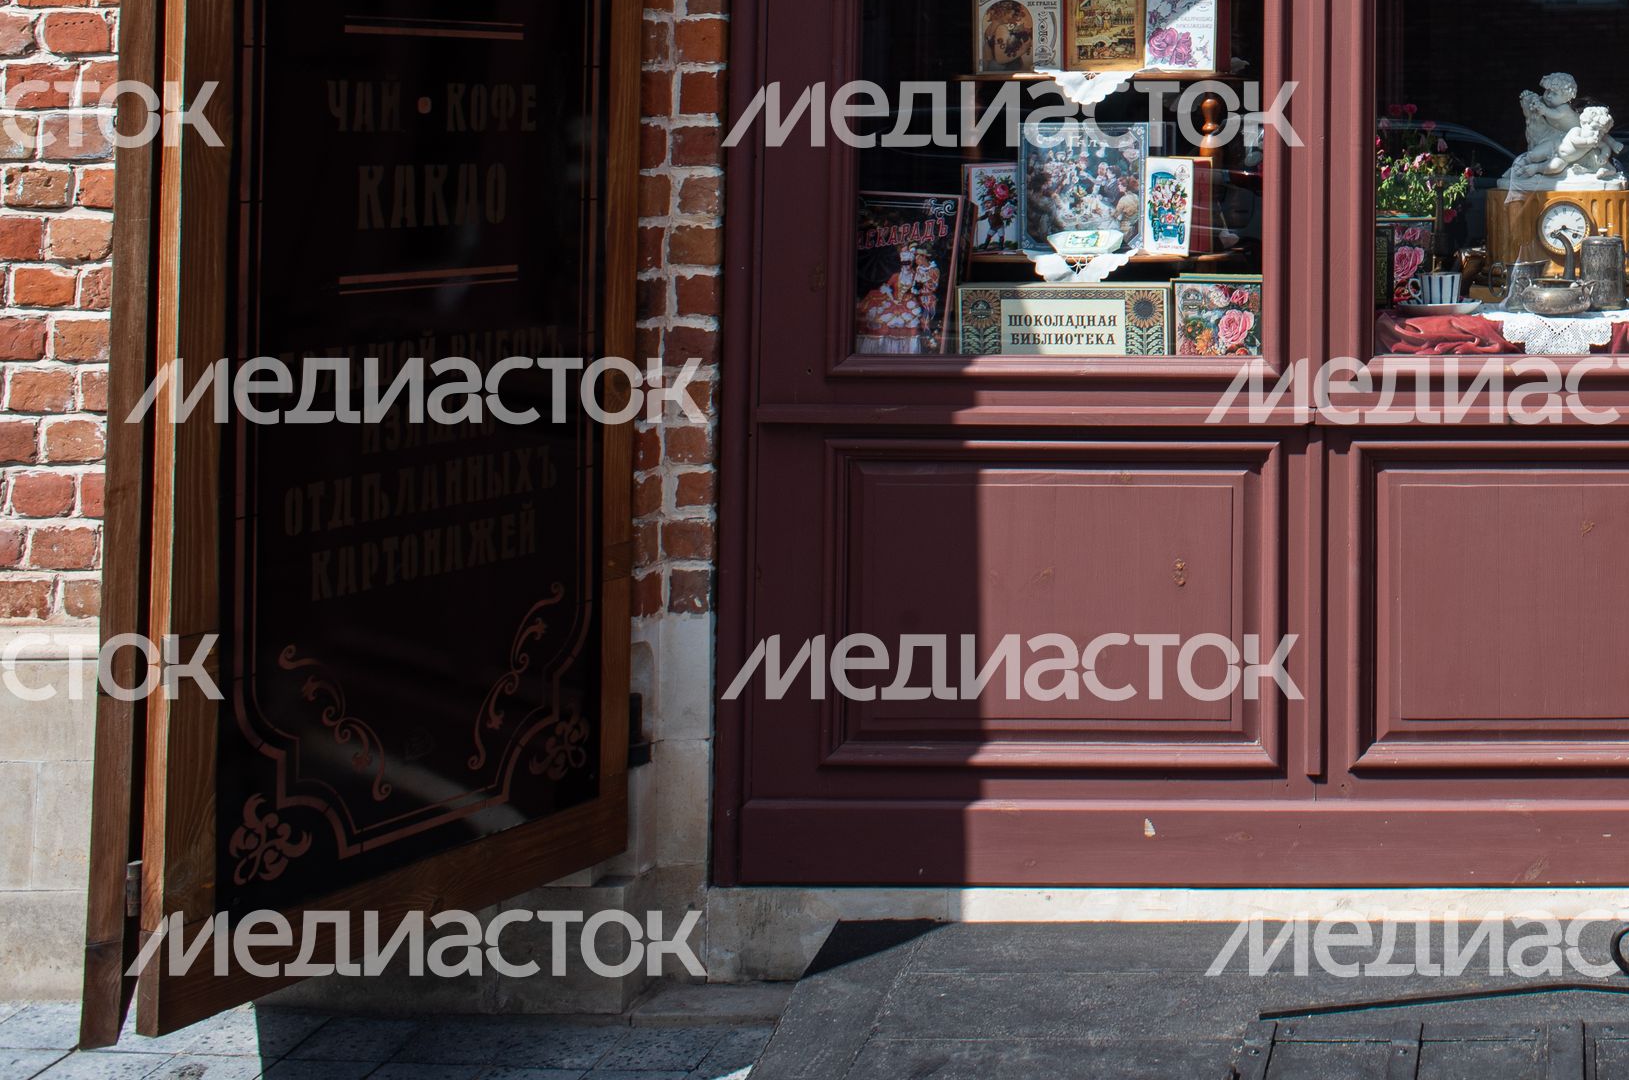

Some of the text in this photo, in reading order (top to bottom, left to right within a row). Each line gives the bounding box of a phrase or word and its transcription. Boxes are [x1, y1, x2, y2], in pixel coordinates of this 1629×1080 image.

[325, 74, 537, 134] ЧАЙ КОФЕ
[356, 162, 508, 231] КАКАО
[857, 217, 949, 250] АСКАРАДЪ
[1008, 313, 1117, 330] ШОКОЛАДНАЯ
[1010, 331, 1117, 346] БИБЛИОТЕКА
[311, 499, 537, 602] КАРТОНАЖЕЙ
